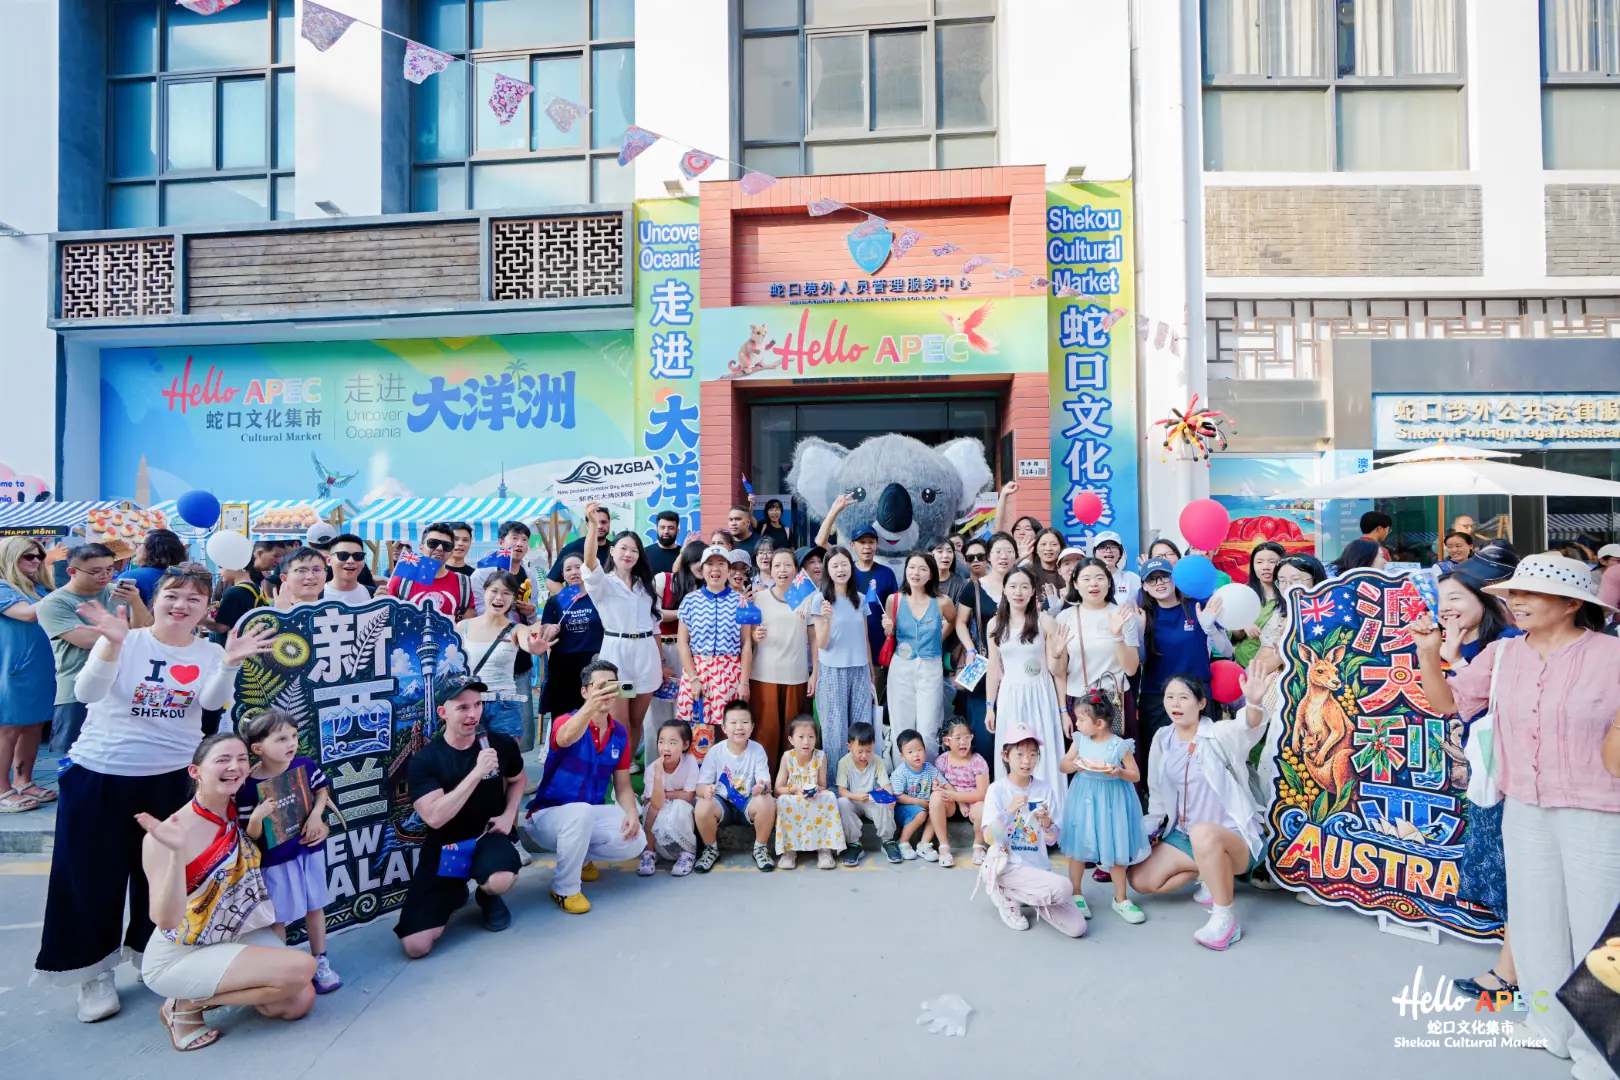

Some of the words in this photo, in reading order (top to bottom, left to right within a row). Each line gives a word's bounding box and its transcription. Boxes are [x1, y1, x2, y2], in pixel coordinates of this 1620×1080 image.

[1049, 206, 1121, 231] Shekou
[639, 222, 700, 243] Uncove
[1049, 236, 1121, 262] Cultural
[769, 277, 971, 298] 蛇口境外人员管理服务中心
[1053, 268, 1119, 294] Market
[773, 308, 869, 376] Hello
[873, 333, 969, 365] APEC
[162, 355, 241, 415] Hello
[243, 377, 322, 405] APEC
[344, 373, 406, 404] 走进
[406, 370, 576, 433] 大洋洲
[205, 408, 322, 430] 蛇口文化集市
[346, 409, 403, 422] Uncover
[240, 432, 283, 442] Cultural
[286, 432, 322, 442] Market
[345, 425, 402, 439] Oceania
[1399, 427, 1455, 439] Shekou
[1456, 427, 1515, 440] Foreign
[1517, 427, 1558, 441] Legal
[1562, 428, 1620, 439] Assista
[603, 460, 655, 476] NZGBA
[144, 658, 167, 683] I
[130, 707, 186, 719] SHEKOU
[307, 607, 395, 826] 新西兰
[326, 823, 383, 867] EW
[1276, 823, 1480, 909] AUSTRA
